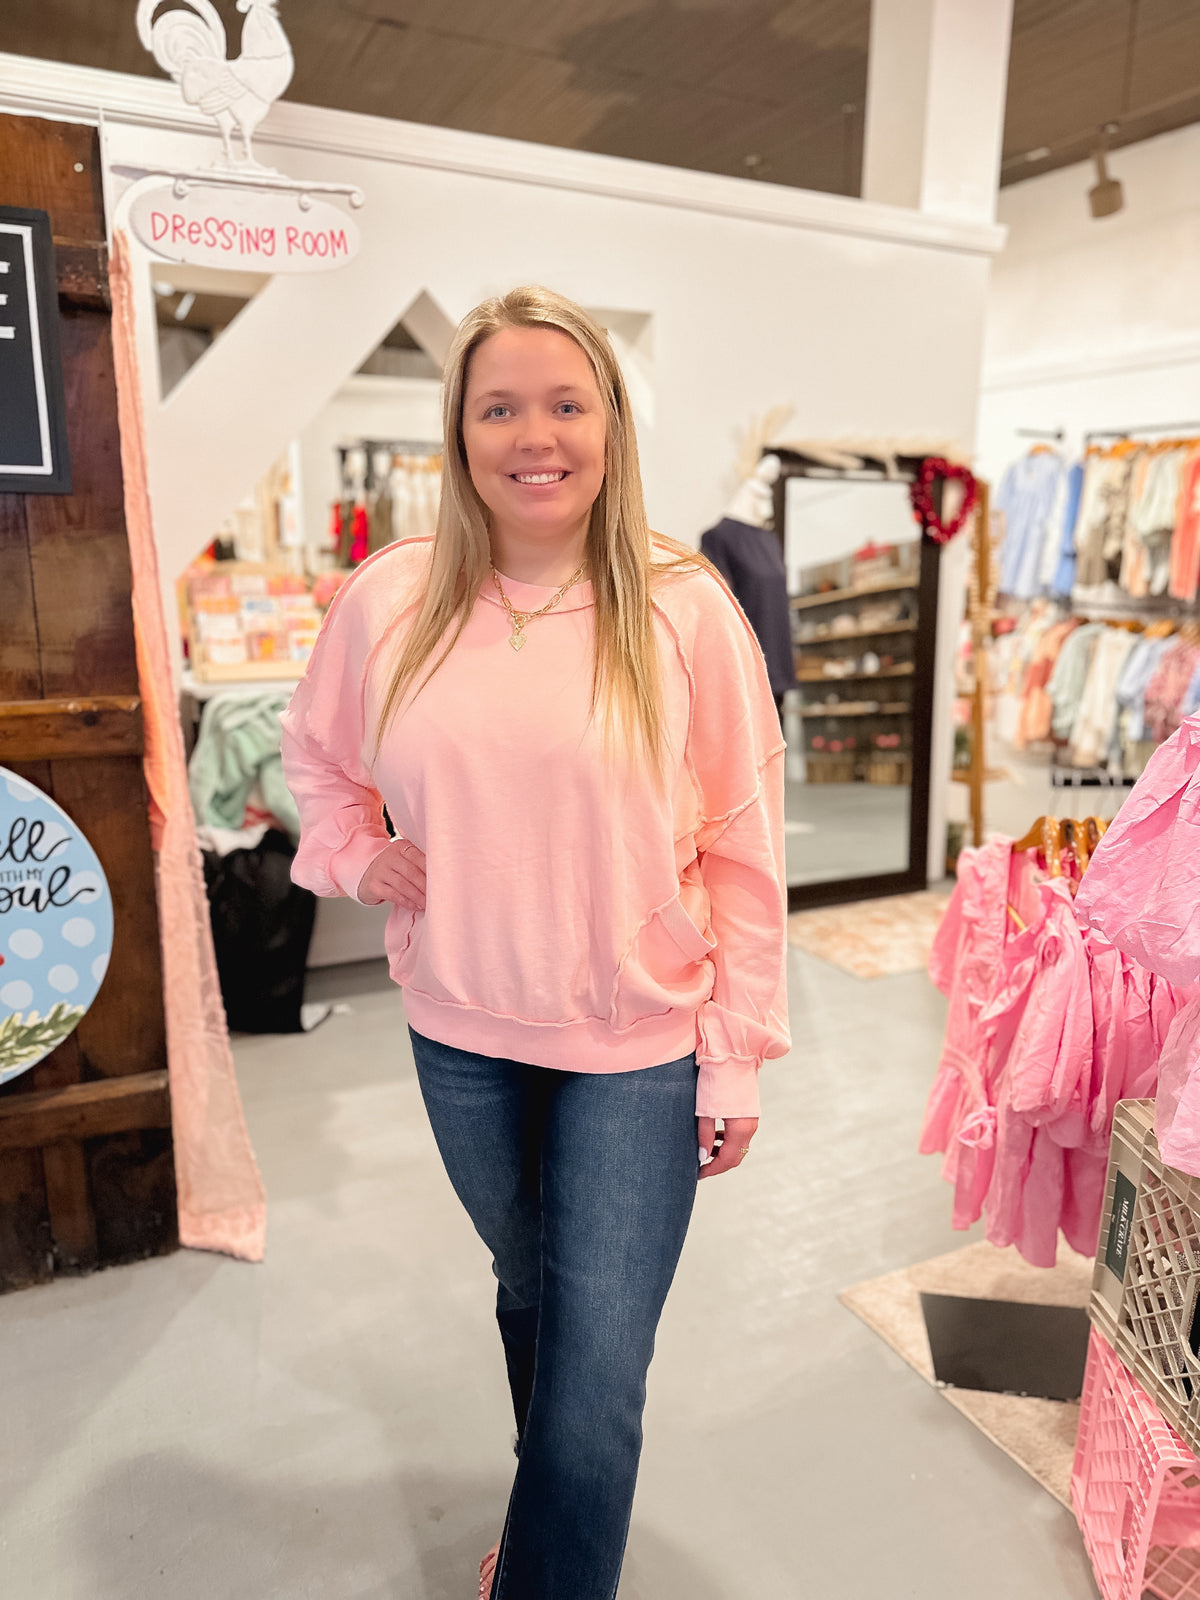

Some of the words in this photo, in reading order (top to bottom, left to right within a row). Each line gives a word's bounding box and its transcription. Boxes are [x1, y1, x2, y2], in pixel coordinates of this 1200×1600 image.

[285, 226, 349, 258] ROOM
[26, 867, 44, 882] MY
[1119, 1197, 1130, 1222] MILK
[1115, 1222, 1126, 1257] CRATE
